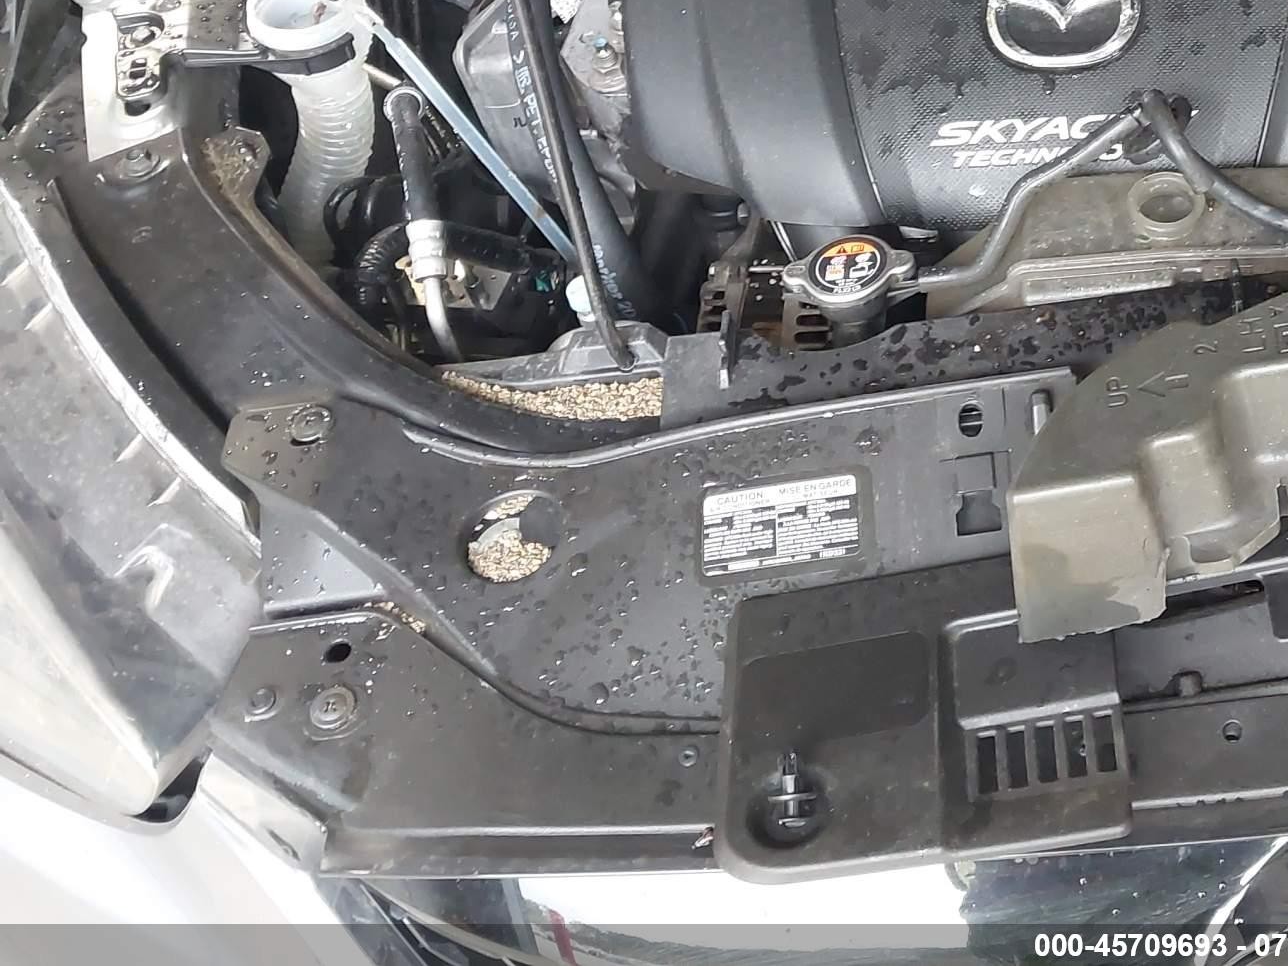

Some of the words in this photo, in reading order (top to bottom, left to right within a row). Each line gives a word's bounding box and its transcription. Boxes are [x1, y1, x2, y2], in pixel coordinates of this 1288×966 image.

[930, 110, 1199, 147] SKYAC
[1106, 376, 1129, 409] UP
[717, 491, 763, 506] CAUTION
[803, 483, 817, 492] EN
